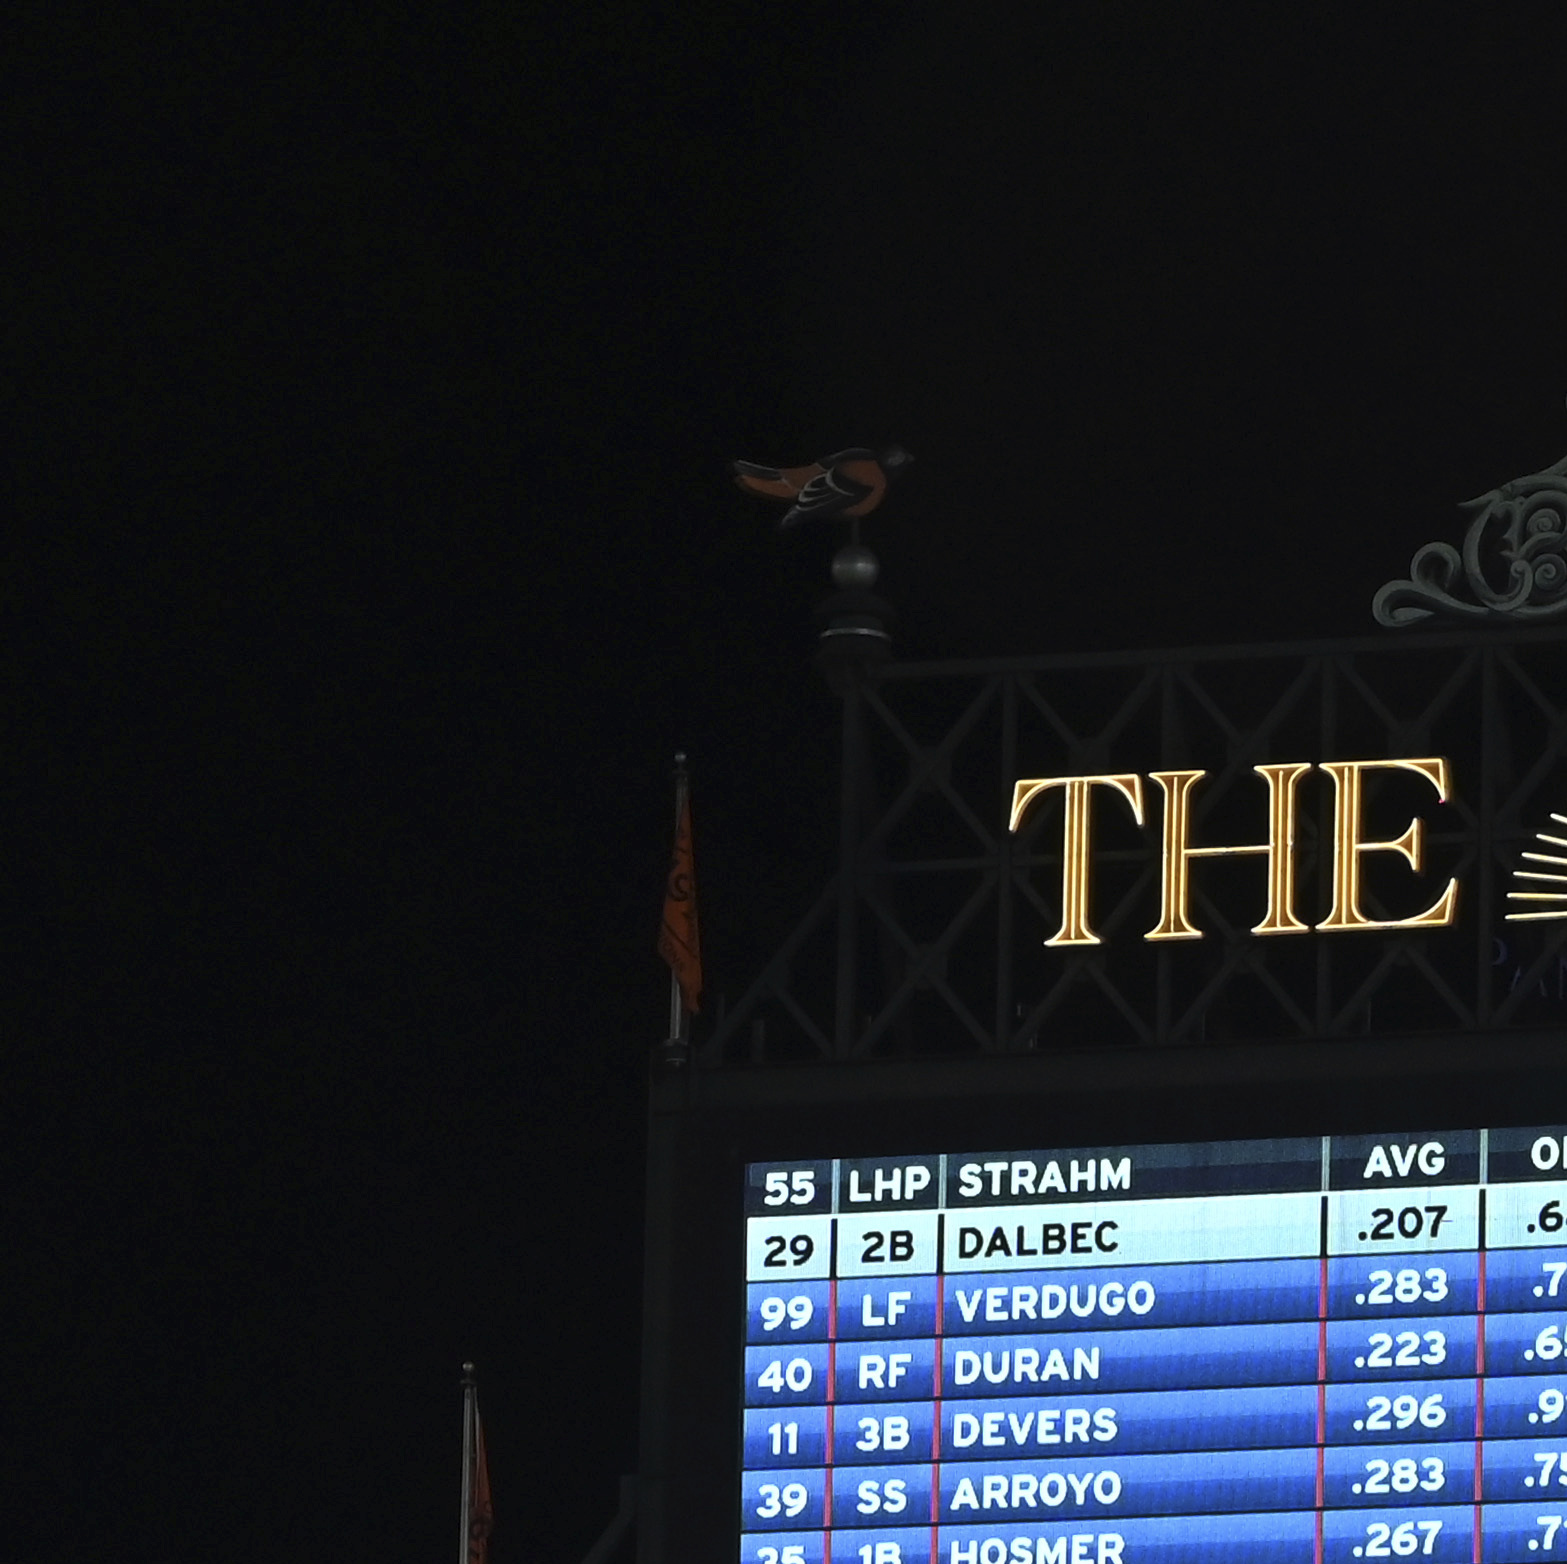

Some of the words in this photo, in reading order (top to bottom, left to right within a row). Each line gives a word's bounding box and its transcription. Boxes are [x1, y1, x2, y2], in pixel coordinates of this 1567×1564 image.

[1008, 757, 1458, 947] THE
[764, 1170, 815, 1206] 55
[849, 1165, 931, 1202] LHP
[958, 1157, 1131, 1197] STRAHM
[1363, 1141, 1445, 1179] AVG
[763, 1234, 814, 1268] 29
[861, 1229, 915, 1264] 2B
[958, 1220, 1119, 1259] DALBEC
[1358, 1205, 1448, 1242] .207
[955, 1280, 1156, 1322] VERDUGO
[954, 1346, 1100, 1385] DURAN
[953, 1407, 1118, 1448] DEVERS
[950, 1470, 1122, 1511] ARROYO
